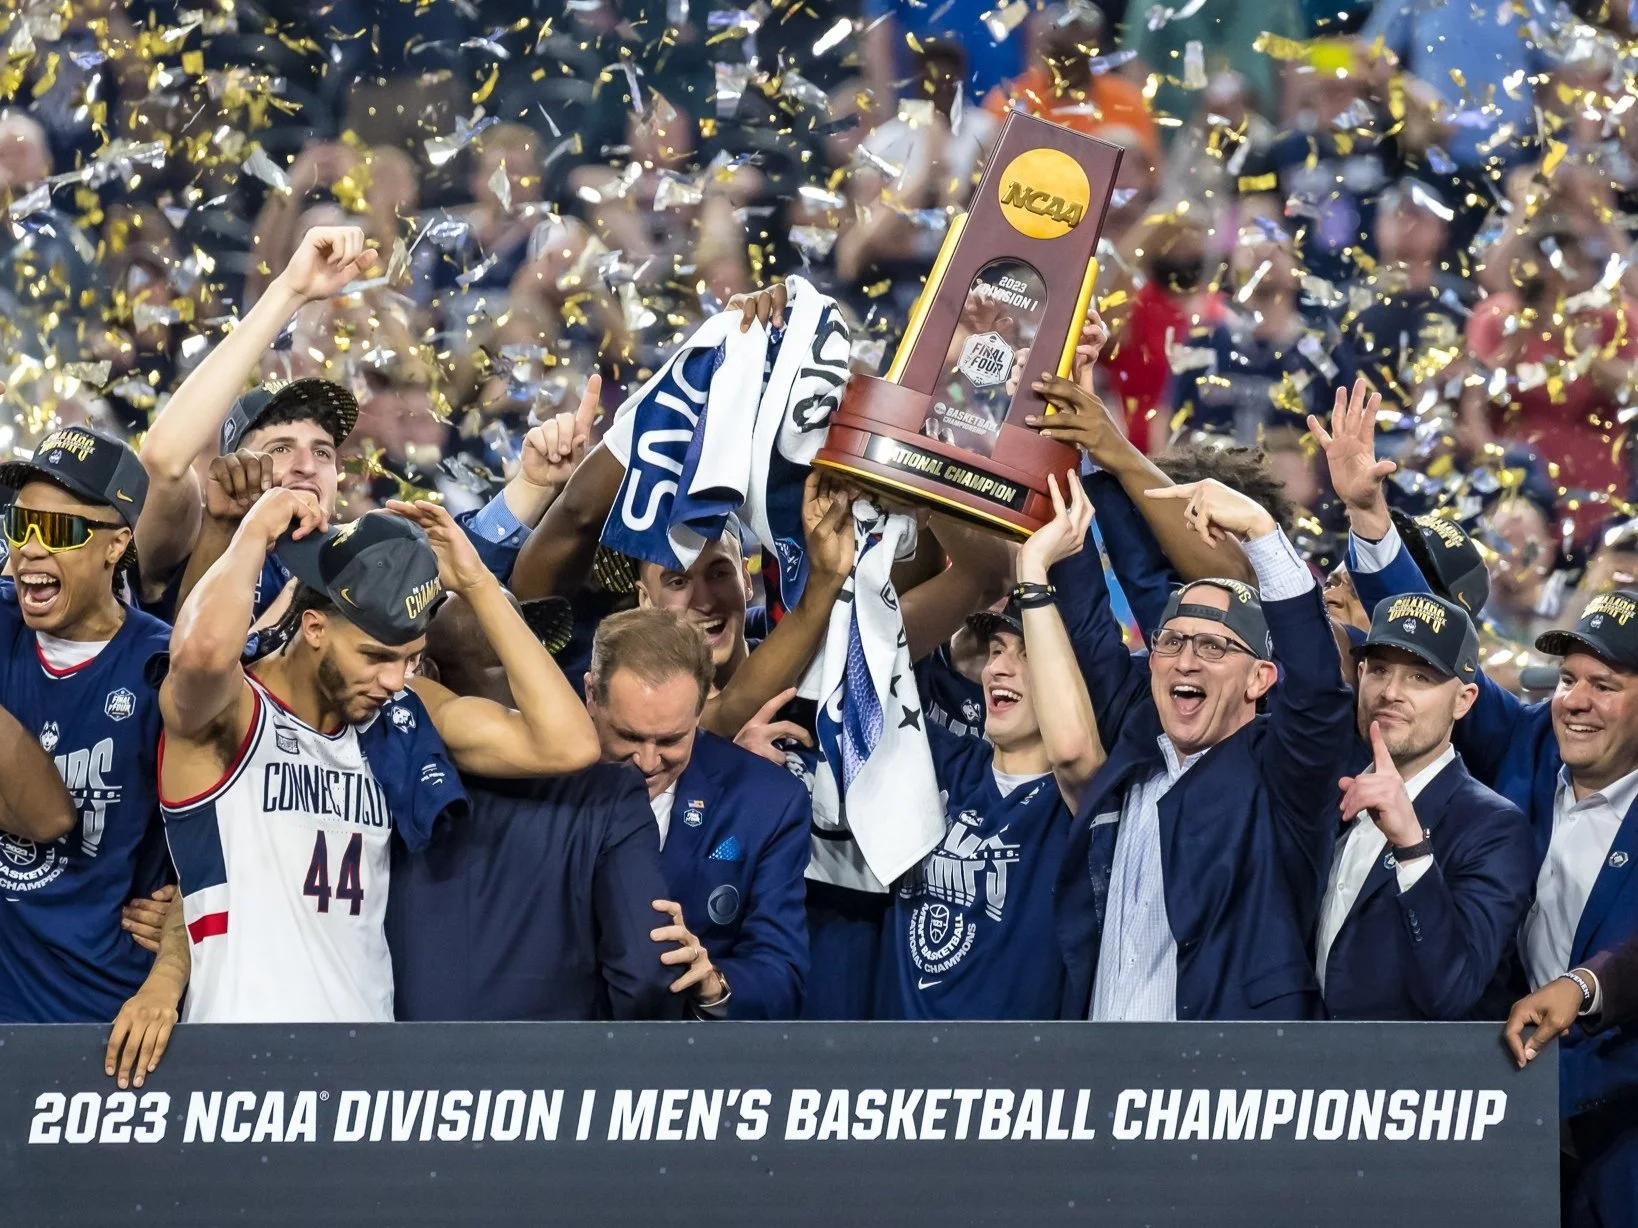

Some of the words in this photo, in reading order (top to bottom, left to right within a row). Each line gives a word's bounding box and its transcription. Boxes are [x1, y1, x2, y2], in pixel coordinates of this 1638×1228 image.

[1001, 181, 1084, 228] NCAA
[983, 283, 1032, 309] DIVISION
[1030, 301, 1039, 312] I
[998, 276, 1028, 293] 2023
[971, 356, 1004, 374] FOUR
[972, 342, 1005, 363] FINAL
[945, 408, 998, 432] BASKETBALL
[882, 445, 941, 476] ATIONAL
[944, 465, 1017, 503] CHAMPION
[0, 847, 56, 881] ASKETBLL
[0, 857, 69, 892] CHAMPIOS
[303, 829, 364, 916] 44
[909, 909, 923, 969] NATIONAL
[924, 923, 977, 974] CHAMPIONS
[921, 912, 964, 961] BASKETBALL
[28, 1091, 171, 1143] 2023
[333, 1089, 565, 1141] DIVISION
[575, 1089, 597, 1141] I
[606, 1089, 772, 1141] MEN'S
[784, 1088, 1096, 1141] BASKETBALL
[1112, 1088, 1508, 1140] CHAMPIONSHIP
